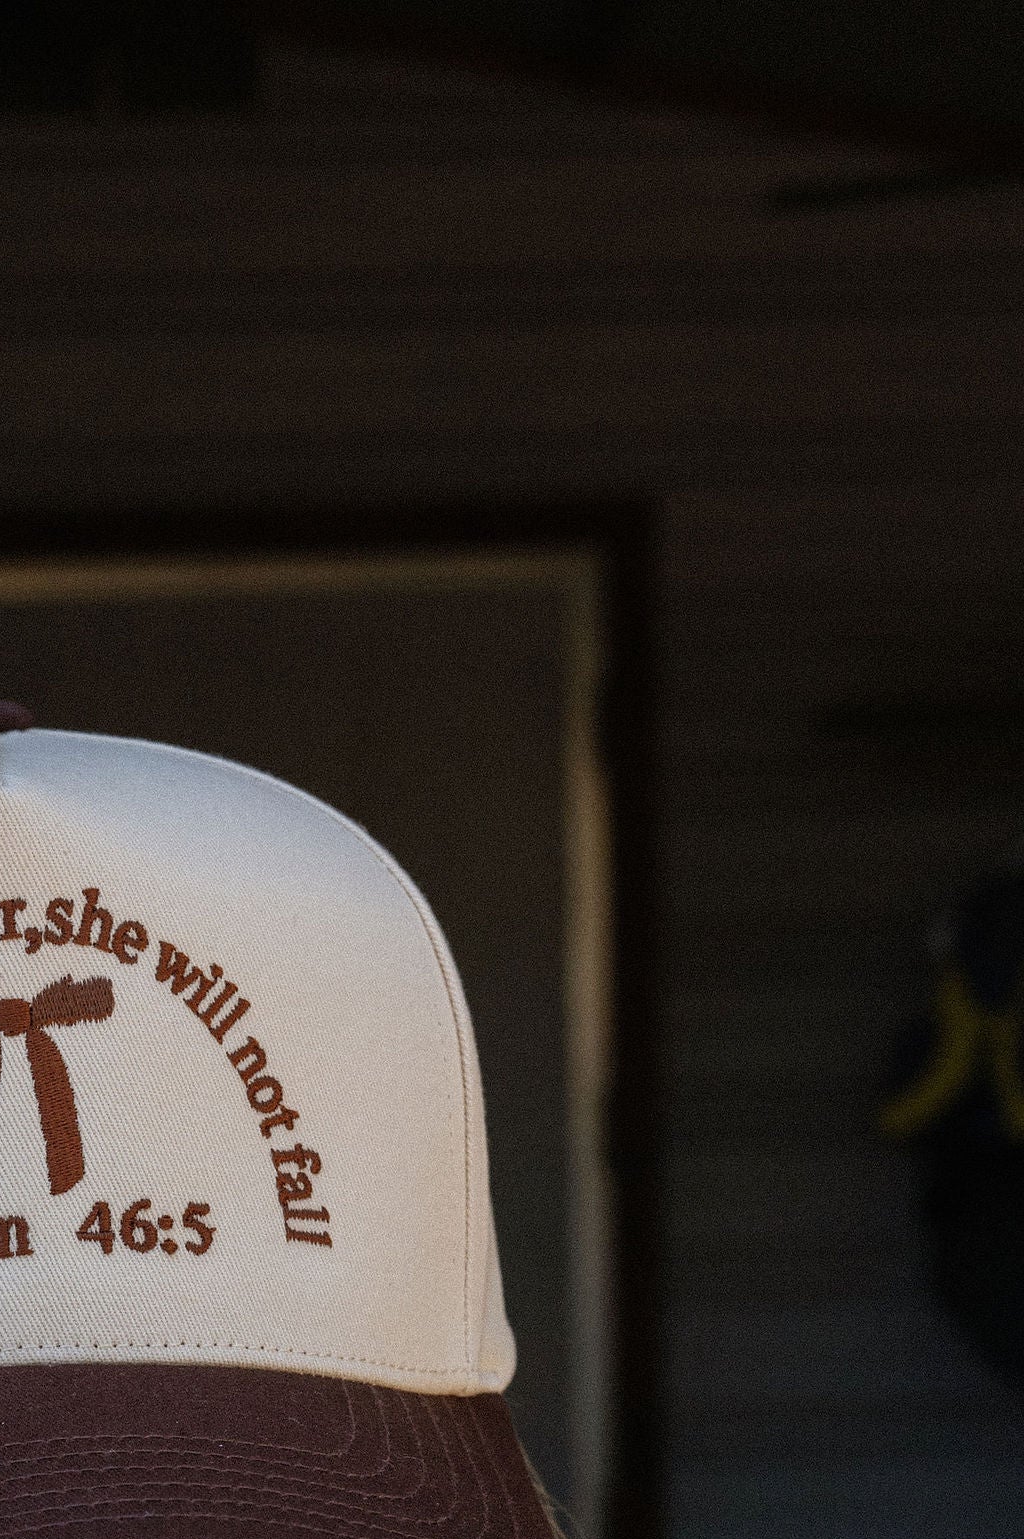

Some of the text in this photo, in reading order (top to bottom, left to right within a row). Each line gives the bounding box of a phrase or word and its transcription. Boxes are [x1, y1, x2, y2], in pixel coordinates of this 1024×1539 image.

[155, 940, 252, 1045] will
[226, 1035, 301, 1140] not
[269, 1141, 333, 1250] fall
[74, 1196, 218, 1258] 46:5
